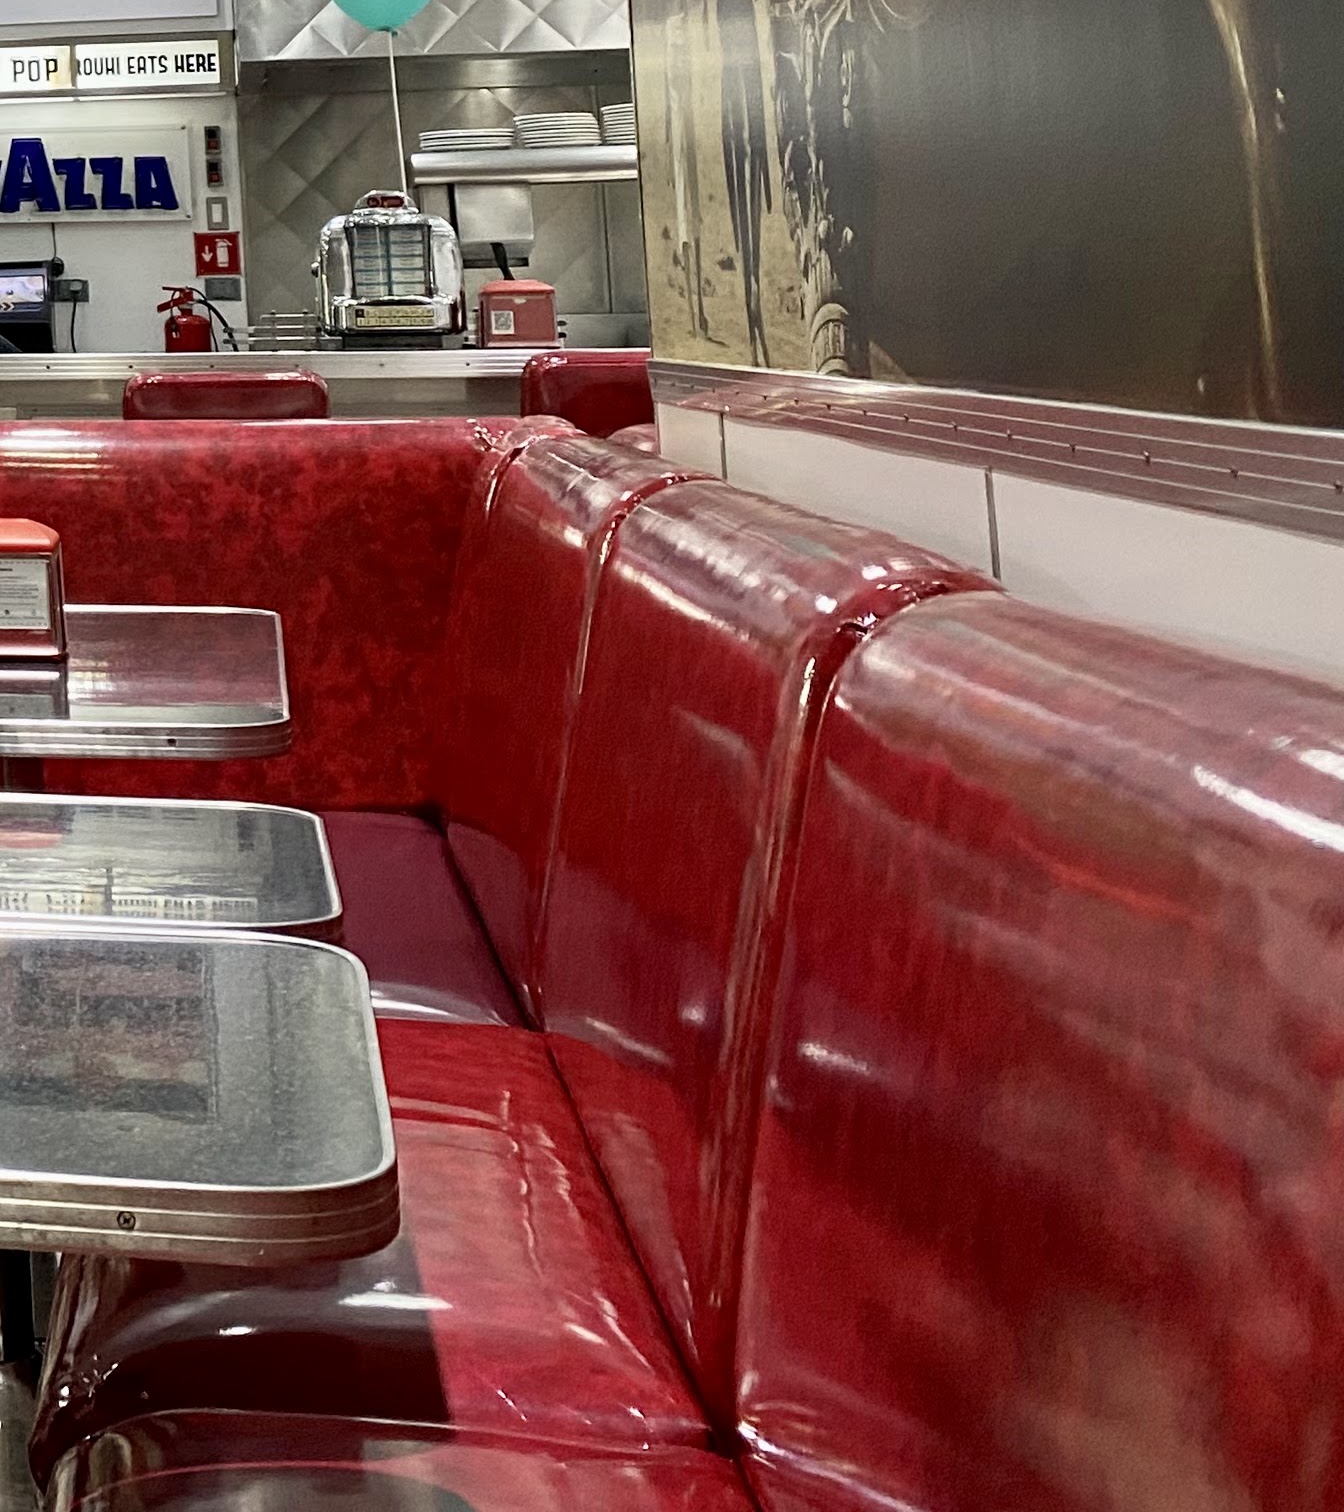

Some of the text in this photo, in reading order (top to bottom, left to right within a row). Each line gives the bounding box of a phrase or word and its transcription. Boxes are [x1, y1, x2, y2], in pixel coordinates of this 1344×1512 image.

[12, 57, 59, 83] POP
[127, 55, 168, 75] EATS
[174, 52, 217, 74] HERE
